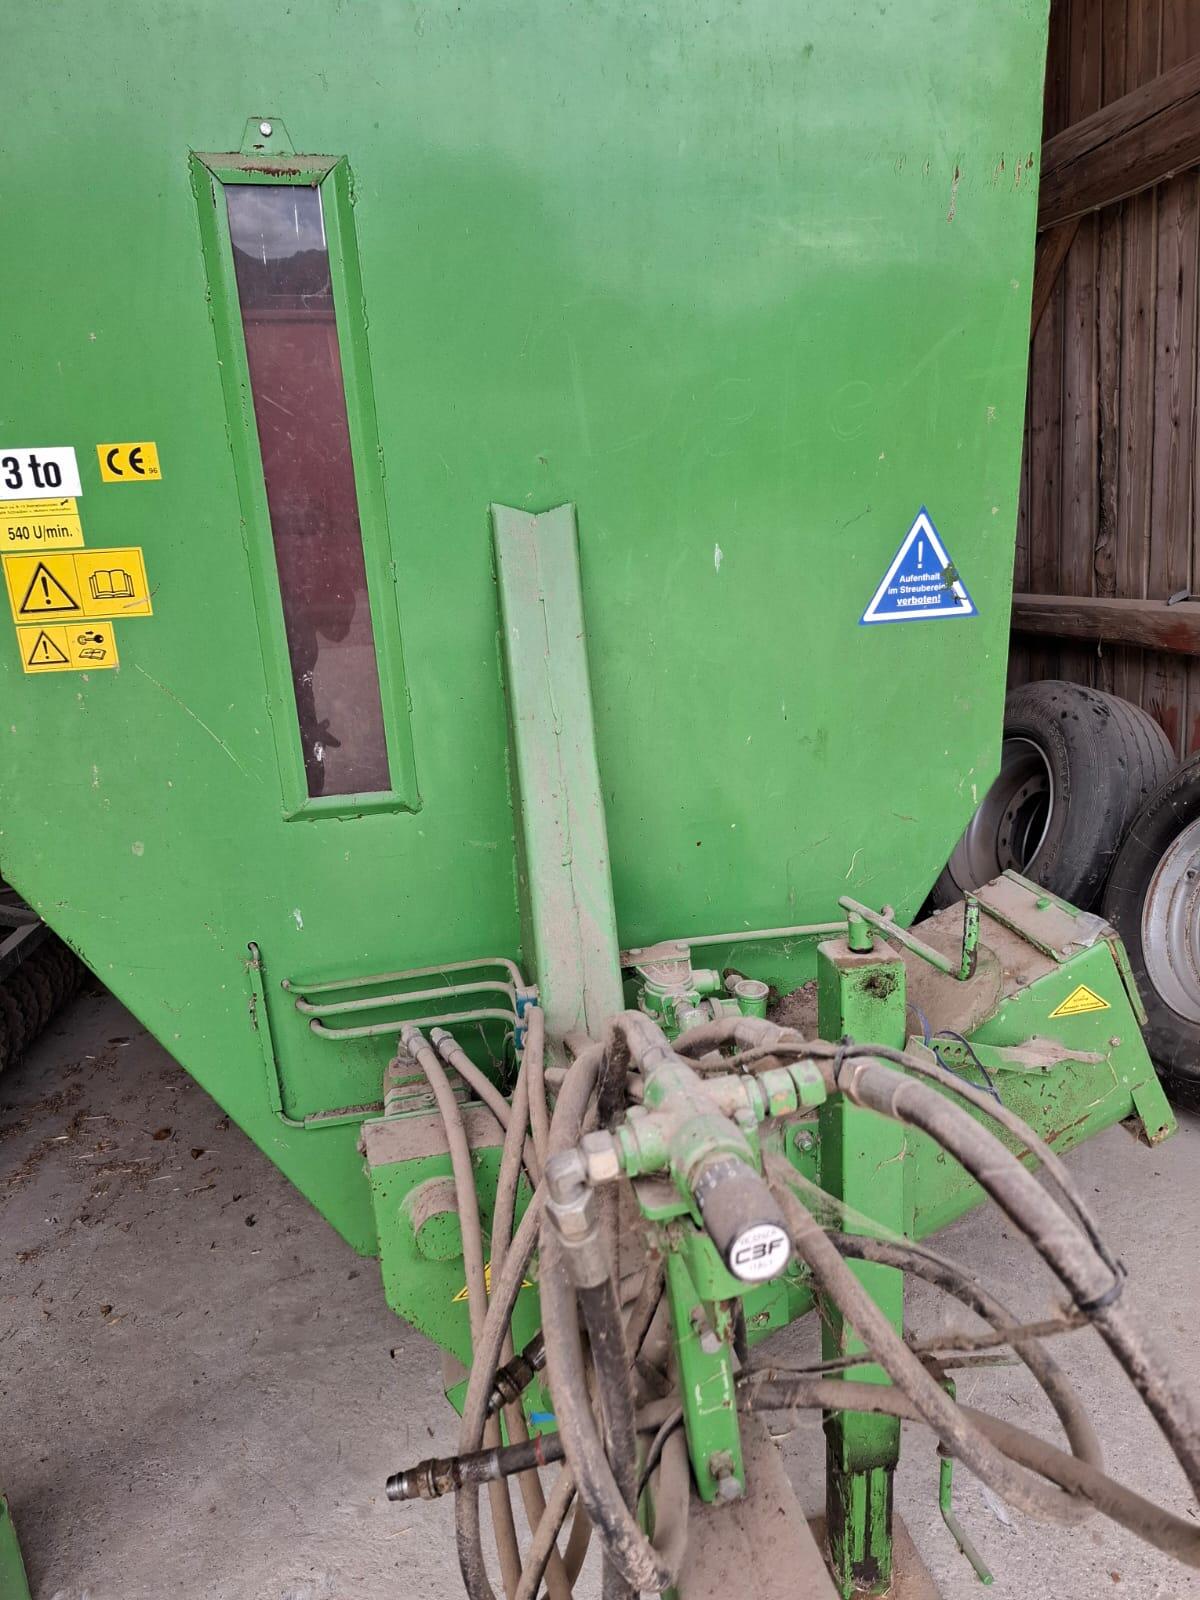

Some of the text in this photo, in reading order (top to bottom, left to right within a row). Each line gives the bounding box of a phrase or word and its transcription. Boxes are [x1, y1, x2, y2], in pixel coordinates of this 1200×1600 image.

[107, 448, 145, 475] CE
[2, 454, 62, 489] 3 to
[8, 524, 73, 542] 540 U/min.
[899, 573, 940, 583] Aufenthalt
[887, 587, 898, 595] im
[896, 594, 941, 606] verboten!
